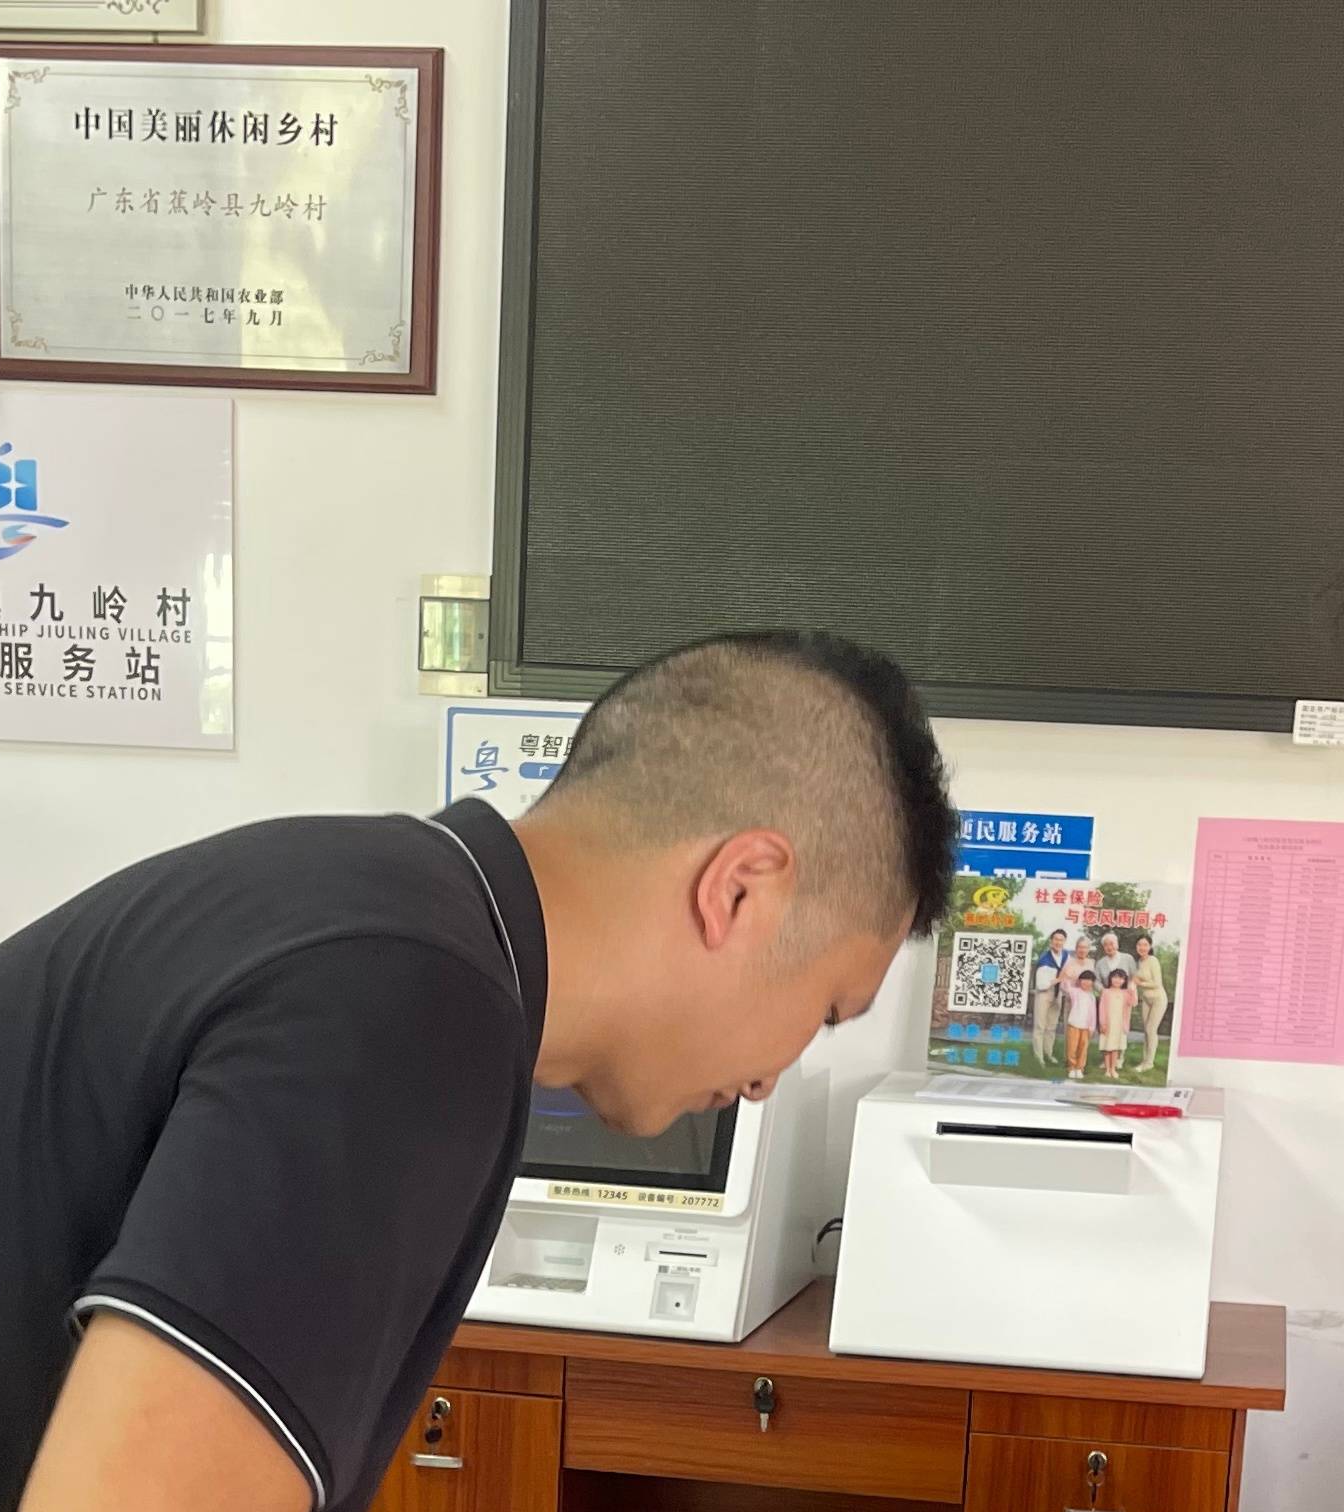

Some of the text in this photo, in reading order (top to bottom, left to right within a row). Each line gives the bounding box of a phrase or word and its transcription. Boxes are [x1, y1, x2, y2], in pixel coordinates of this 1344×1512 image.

[74, 106, 338, 146] 中国美丽休闲乡村
[87, 186, 327, 221] 广东省蕉岭县九岭村
[125, 283, 284, 305] 中华人民共和国农业部
[37, 624, 110, 642] JIULING
[118, 627, 192, 645] VILLAGE
[4, 681, 78, 699] SERVICE
[86, 684, 162, 701] STATION
[1035, 888, 1105, 905] 社会保险
[1065, 909, 1168, 928] 与您风雨同舟
[597, 1189, 629, 1200] 12345
[681, 1197, 720, 1208] 207772
